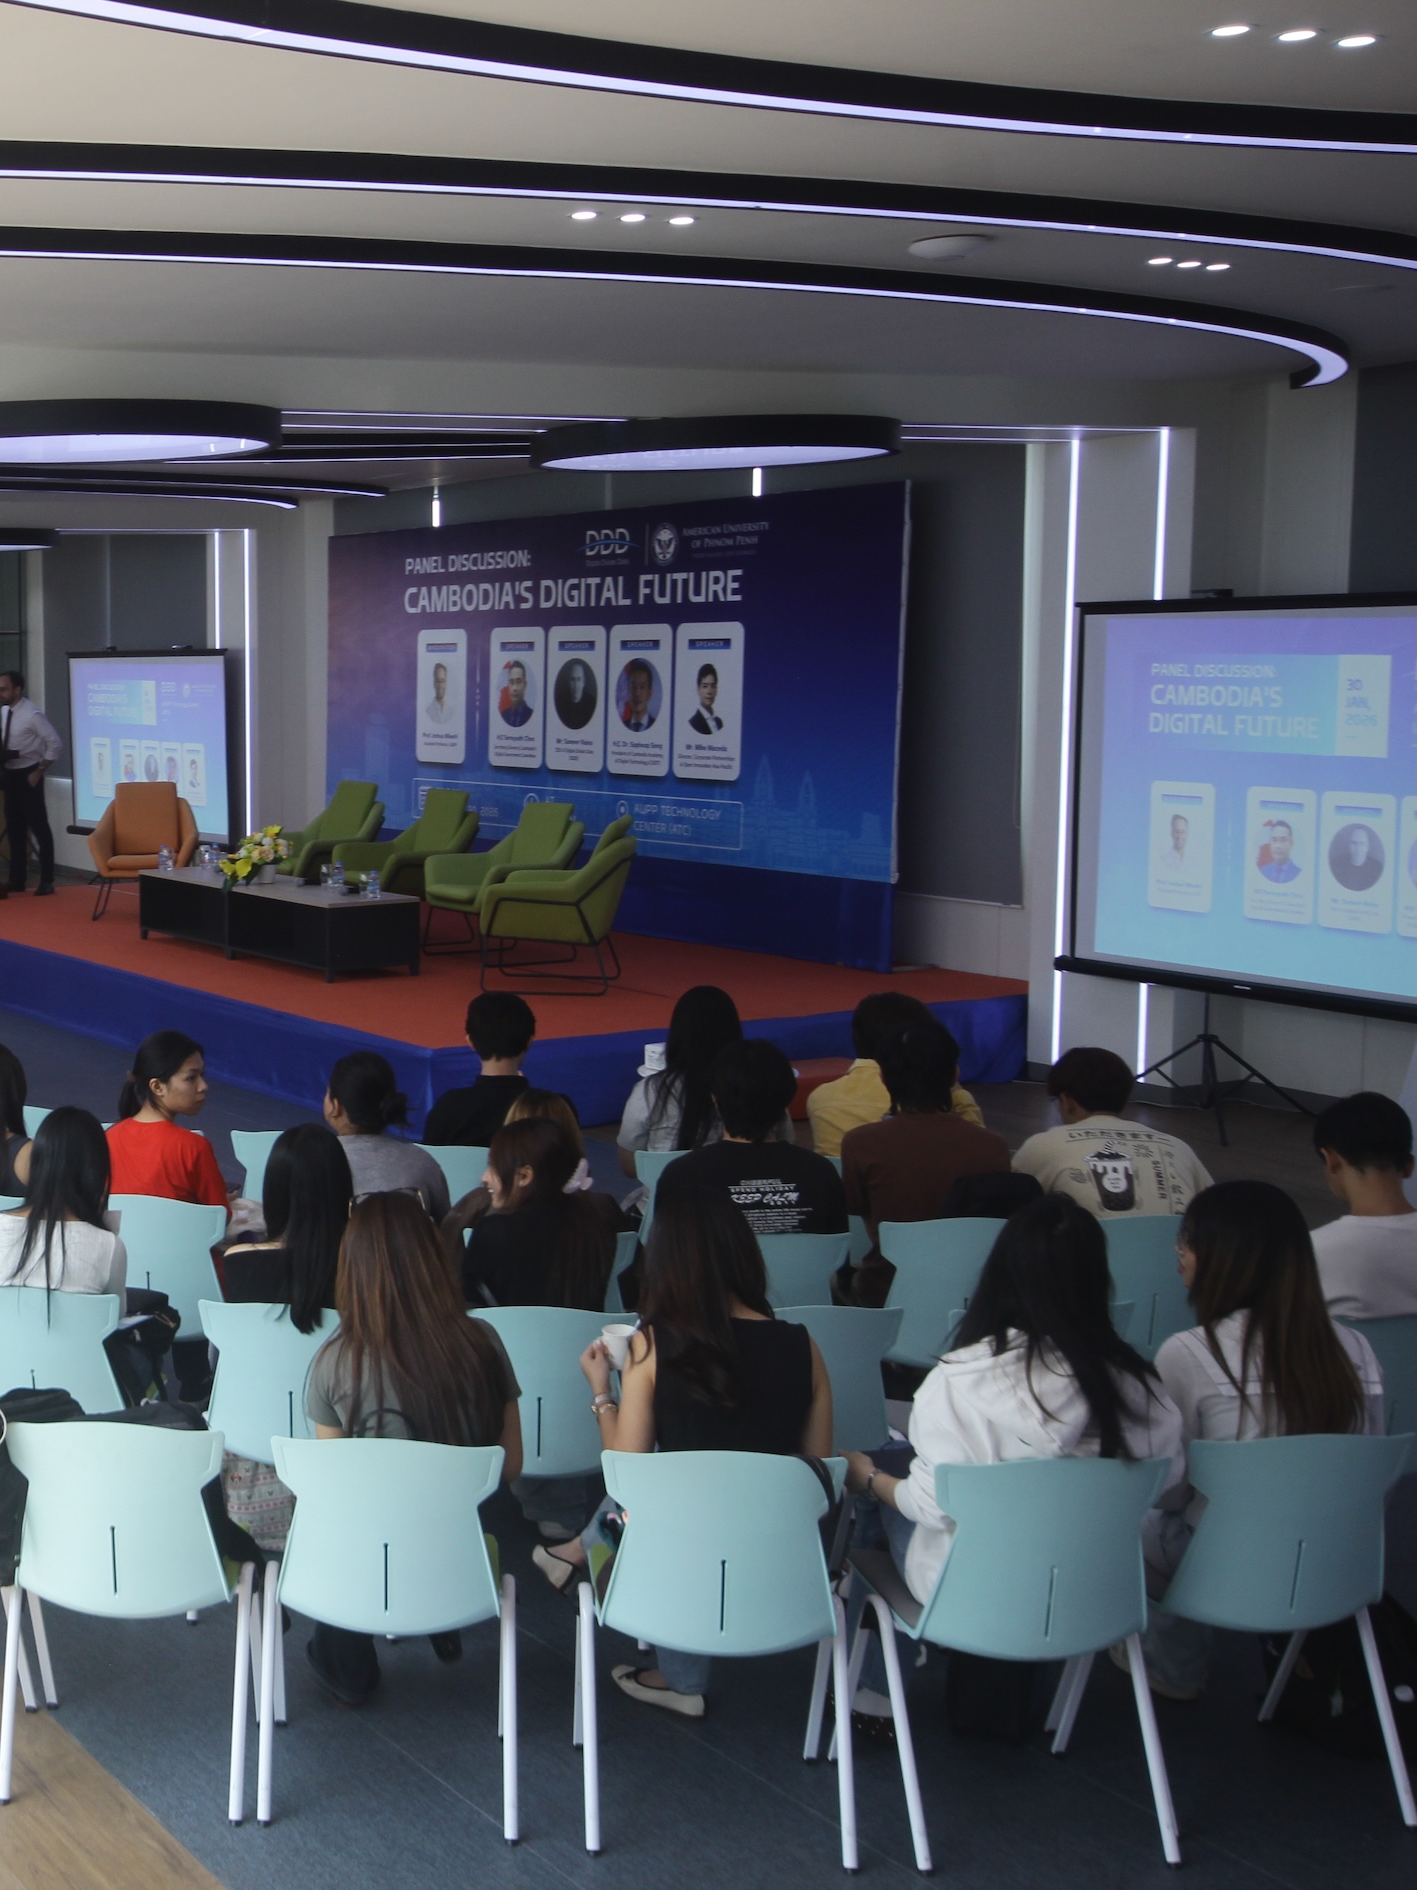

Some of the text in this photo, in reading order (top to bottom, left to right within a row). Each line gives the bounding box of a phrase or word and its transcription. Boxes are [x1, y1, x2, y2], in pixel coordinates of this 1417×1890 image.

[723, 521, 770, 535] UNIVERSITY
[585, 528, 630, 556] DDD
[735, 535, 759, 546] PENH
[405, 550, 531, 575] PANEL DISCUSSION:
[404, 569, 743, 613] CAMBODIA'S DIGITAL FUTURE
[1150, 663, 1276, 678] PANEL DISCUSSION:
[1150, 684, 1282, 707] CAMBODIA'S
[1149, 712, 1319, 739] DIGITAL FUTURE
[634, 804, 722, 820] AUPP TECHNOLOGY
[634, 820, 668, 834] CENTER
